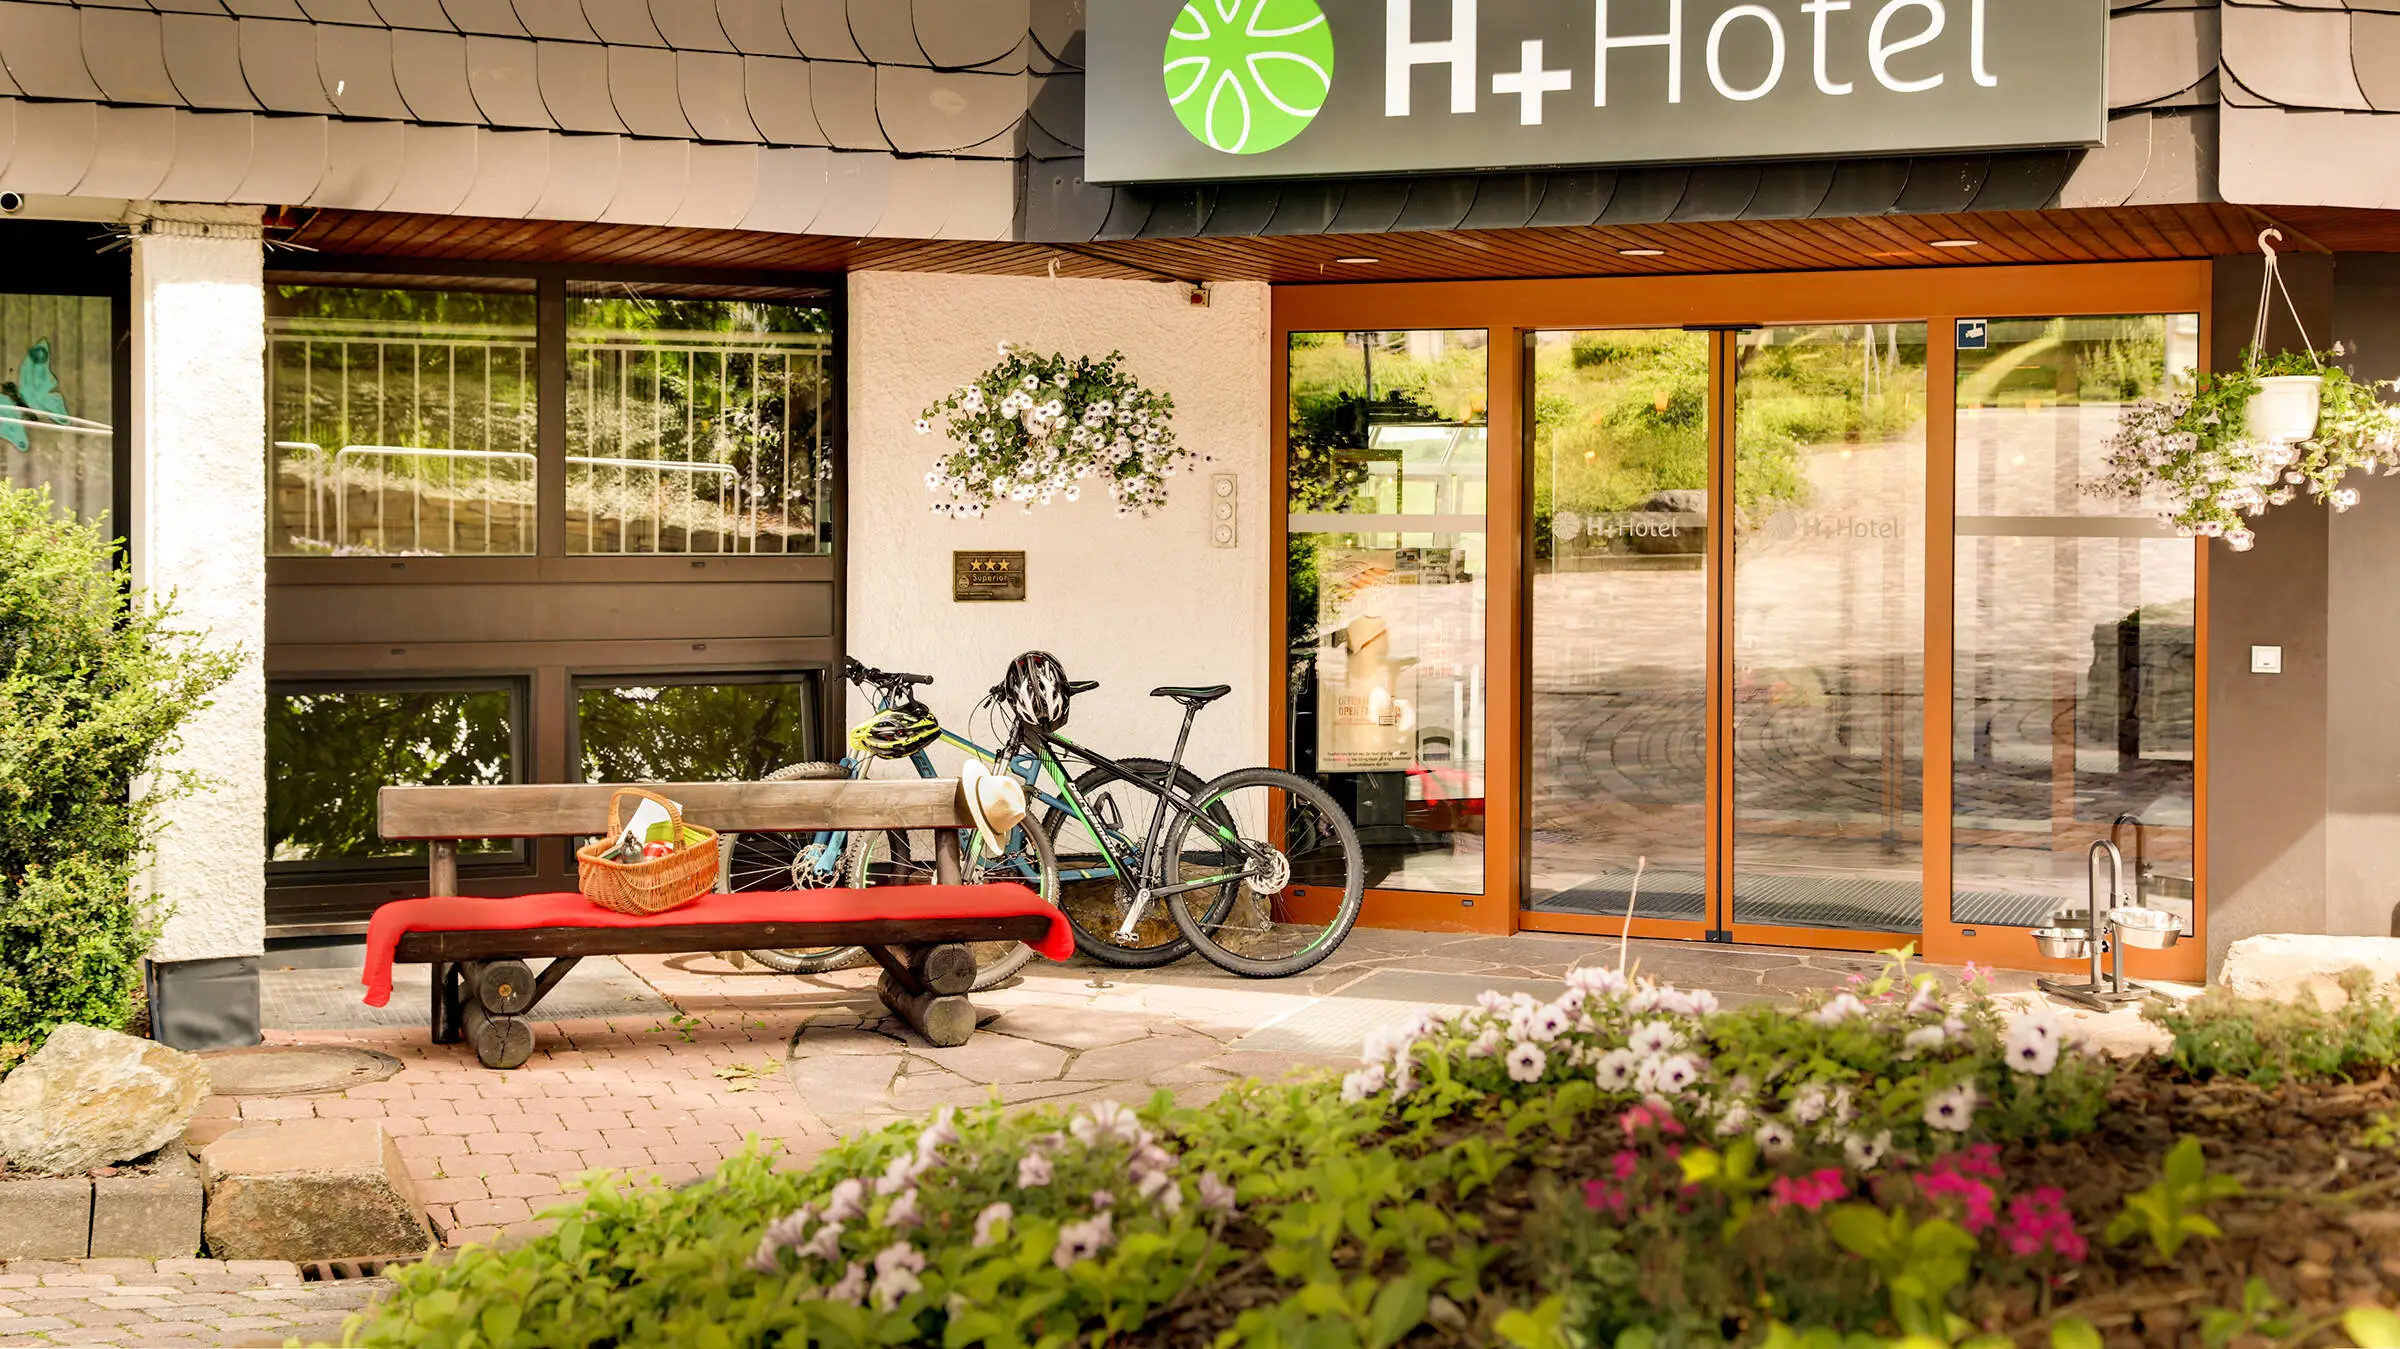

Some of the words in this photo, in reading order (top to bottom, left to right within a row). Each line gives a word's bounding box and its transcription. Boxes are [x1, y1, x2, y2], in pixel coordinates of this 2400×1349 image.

[1385, 0, 1998, 125] H+Hotel
[1587, 516, 1678, 539] H+Hotel
[972, 573, 1008, 583] Superior
[1067, 782, 1121, 859] bergamont
